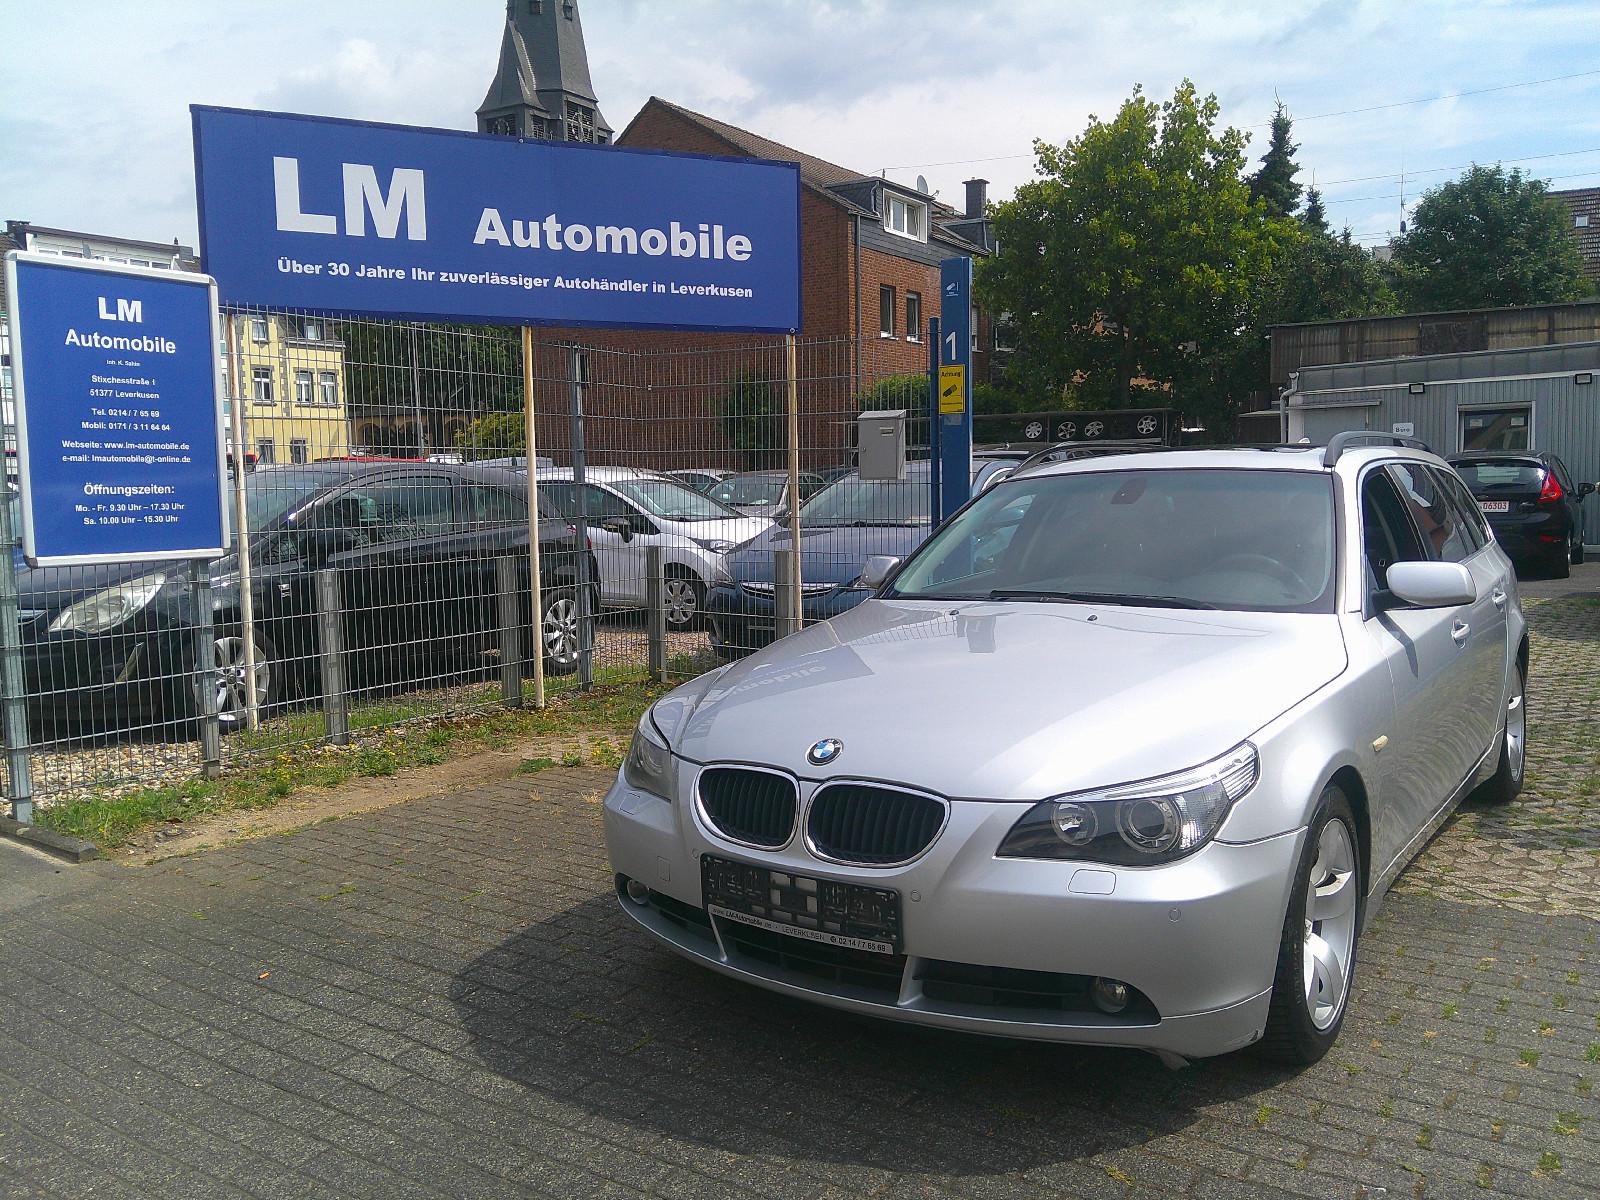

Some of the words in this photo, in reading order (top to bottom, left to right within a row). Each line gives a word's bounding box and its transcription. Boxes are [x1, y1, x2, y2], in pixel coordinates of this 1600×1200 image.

[273, 156, 427, 241] LM
[472, 207, 753, 261] Automobile
[277, 256, 323, 275] Über
[327, 262, 350, 277] 30
[354, 264, 406, 280] Jahre
[411, 267, 436, 281] Ihr
[439, 271, 550, 290] zuverlässiger
[553, 275, 649, 293] Autohändler
[652, 281, 666, 294] in
[670, 282, 753, 298] Leverkusen
[97, 296, 143, 323] LM
[64, 328, 177, 354] Automobile
[945, 331, 956, 361] 1
[91, 374, 150, 386] Stixchesstraße
[151, 378, 156, 386] 1
[89, 388, 114, 397] 51377
[115, 389, 160, 399] Leverkusen
[91, 407, 107, 416] Tel.
[108, 408, 128, 417] 0214
[139, 409, 150, 418] 65
[150, 410, 160, 418] 69
[81, 421, 107, 429] Mobil:
[108, 422, 127, 430] 0171
[139, 423, 149, 431] 11
[150, 423, 161, 431] 64
[161, 423, 171, 431] 64
[61, 439, 103, 449] Webseite:
[103, 441, 190, 451] www.lm-automobile.de
[62, 454, 90, 462] e-mail:
[91, 454, 191, 465] lmautomobile@t-online.de
[83, 482, 175, 497] Öffnungszeiten:
[75, 504, 90, 512] Mo.
[96, 504, 108, 512] Fr.
[109, 503, 127, 512] 9.30
[127, 503, 142, 511] Uhr
[150, 502, 170, 511] 17.30
[171, 502, 185, 510] Uhr
[83, 517, 97, 525] Sa.
[98, 516, 120, 525] 10.00
[120, 516, 136, 524] Uhr
[143, 515, 164, 523] 15.30
[165, 514, 179, 523] Uhr
